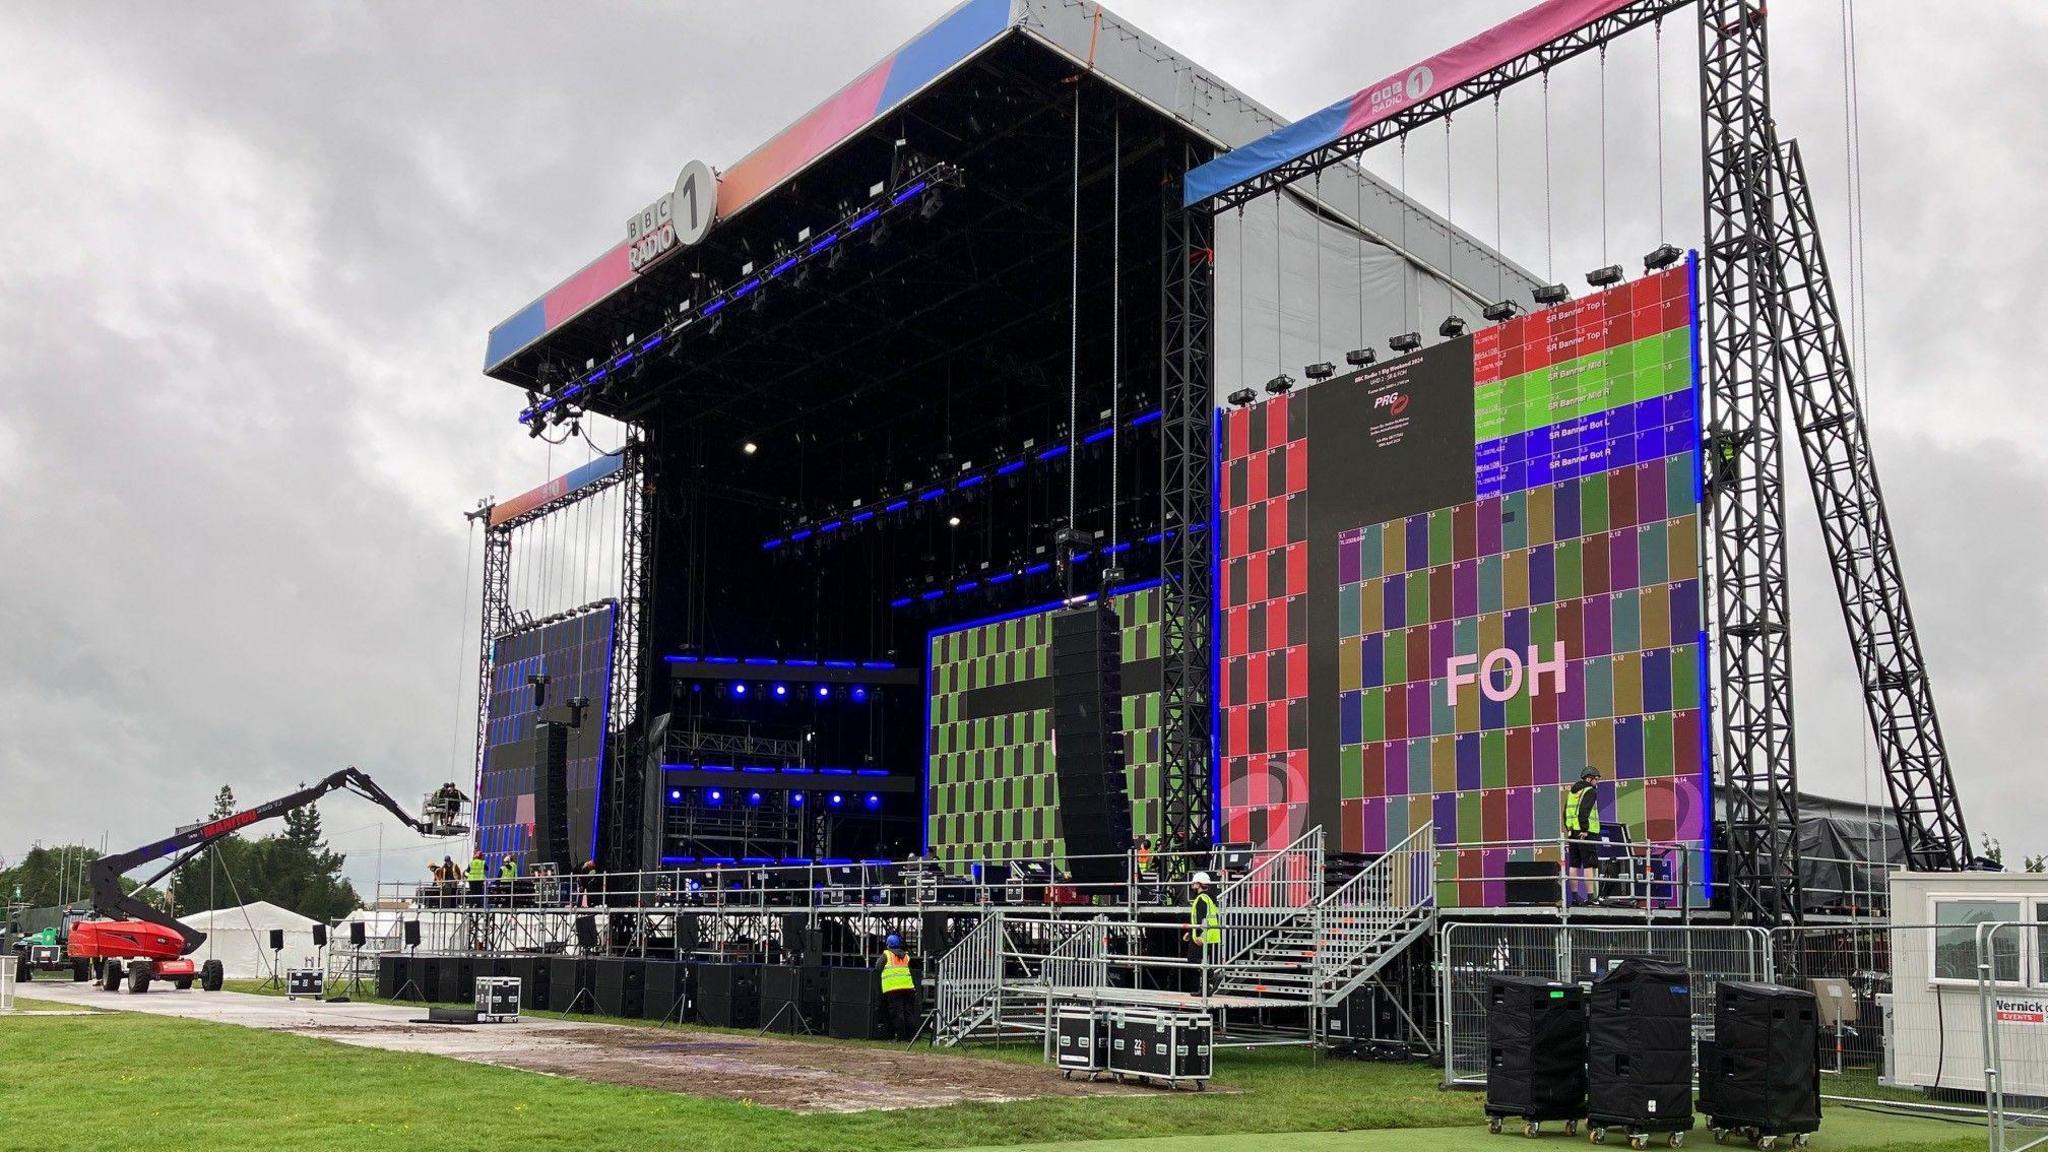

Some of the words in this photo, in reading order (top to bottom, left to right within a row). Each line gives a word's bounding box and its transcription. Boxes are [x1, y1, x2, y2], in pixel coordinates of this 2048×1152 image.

[1372, 94, 1403, 115] RADIO
[1415, 71, 1424, 93] 1
[683, 173, 698, 231] 1
[629, 198, 669, 240] BBC
[628, 225, 675, 269] RADIO
[1546, 313, 1556, 324] SR
[1558, 304, 1584, 320] Banner
[1586, 299, 1600, 312] Top
[1547, 342, 1557, 353] SR
[1559, 334, 1584, 349] Banner
[1587, 329, 1601, 342] Top
[1374, 392, 1399, 409] PRG
[1549, 430, 1559, 440] SR
[1560, 423, 1586, 437] Banner
[1589, 418, 1603, 430] Bot
[1549, 459, 1559, 469] SR
[1561, 453, 1587, 466] Banner
[1589, 448, 1604, 460] Bot
[1447, 640, 1566, 706] FOH
[1134, 1039, 1142, 1050] 22
